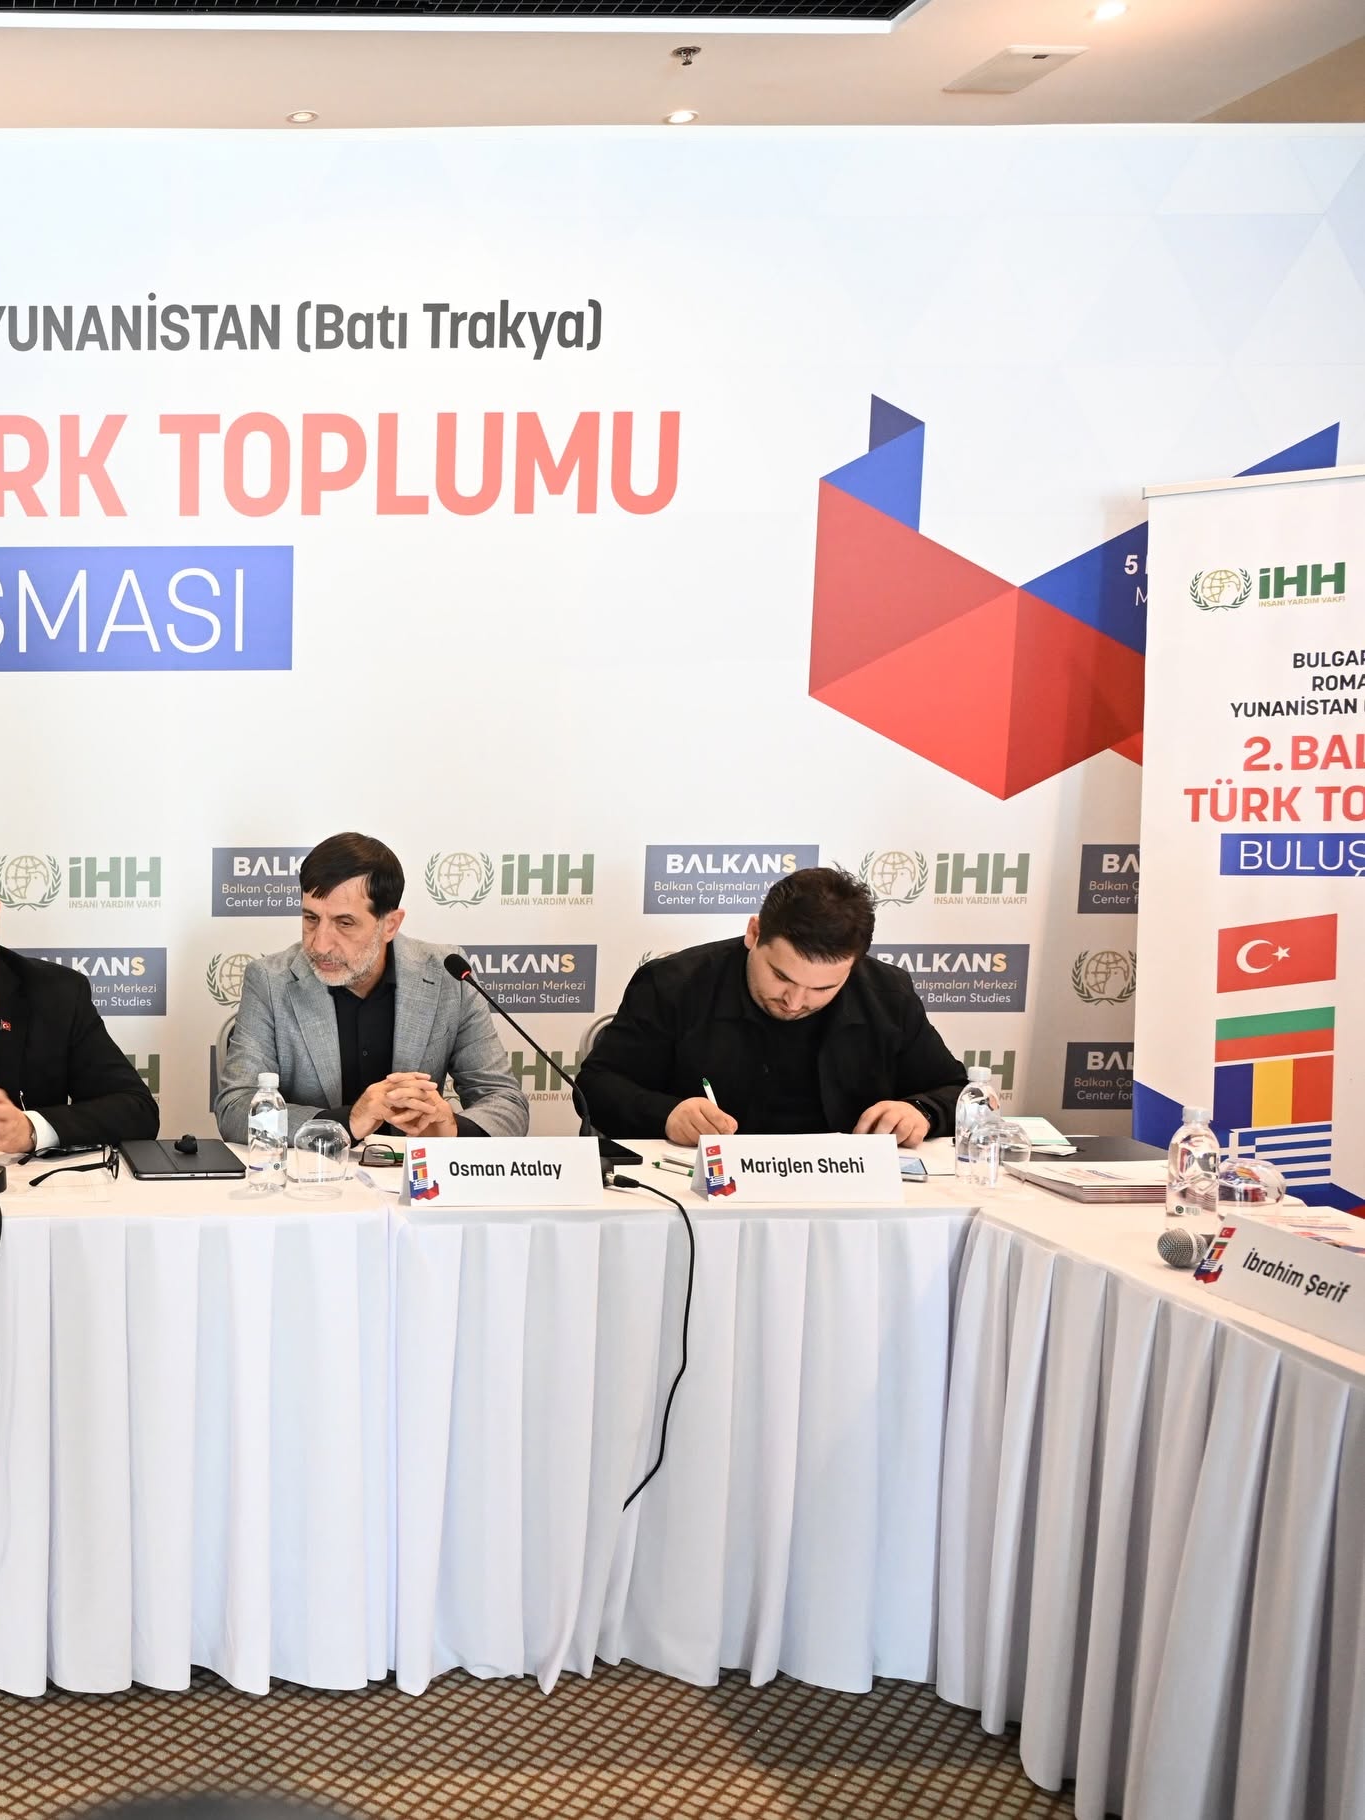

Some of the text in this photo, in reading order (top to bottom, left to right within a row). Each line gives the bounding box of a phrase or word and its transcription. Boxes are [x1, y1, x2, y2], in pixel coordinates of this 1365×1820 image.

[296, 301, 407, 353] (Batı
[423, 299, 602, 360] Trakya)
[159, 411, 680, 517] TOPLUMU
[1124, 554, 1138, 575] 5
[1312, 674, 1365, 691] ROMA
[1230, 696, 1357, 718] YUNANİSTAN
[1184, 778, 1302, 822] TÜRK
[666, 854, 796, 874] BALKANS
[1240, 840, 1365, 876] BULUŞ
[233, 856, 306, 877] BALK
[222, 883, 302, 896] Balkan Çalışm
[654, 881, 693, 891] Balkan
[1089, 881, 1129, 891] Balkan
[226, 897, 264, 907] Center
[267, 896, 282, 907] for
[658, 895, 696, 905] Center
[699, 894, 715, 905] for
[718, 894, 757, 905] Balkan
[1092, 894, 1131, 904] Center
[469, 953, 575, 974] ALKANS
[113, 983, 157, 993] Merkezi
[543, 980, 586, 990] Merkezi
[913, 980, 1017, 992] alışmaları Merkezi
[111, 996, 152, 1007] Studies
[498, 993, 580, 1004] Balkan Studies
[927, 993, 1011, 1003] Balkan Studies
[1074, 1077, 1112, 1088] Balkan
[1076, 1090, 1115, 1101] Center
[449, 1161, 562, 1180] Osman Atalay
[740, 1157, 865, 1177] Mariglen Shehi
[1243, 1248, 1352, 1303] İbrahim Şerif
